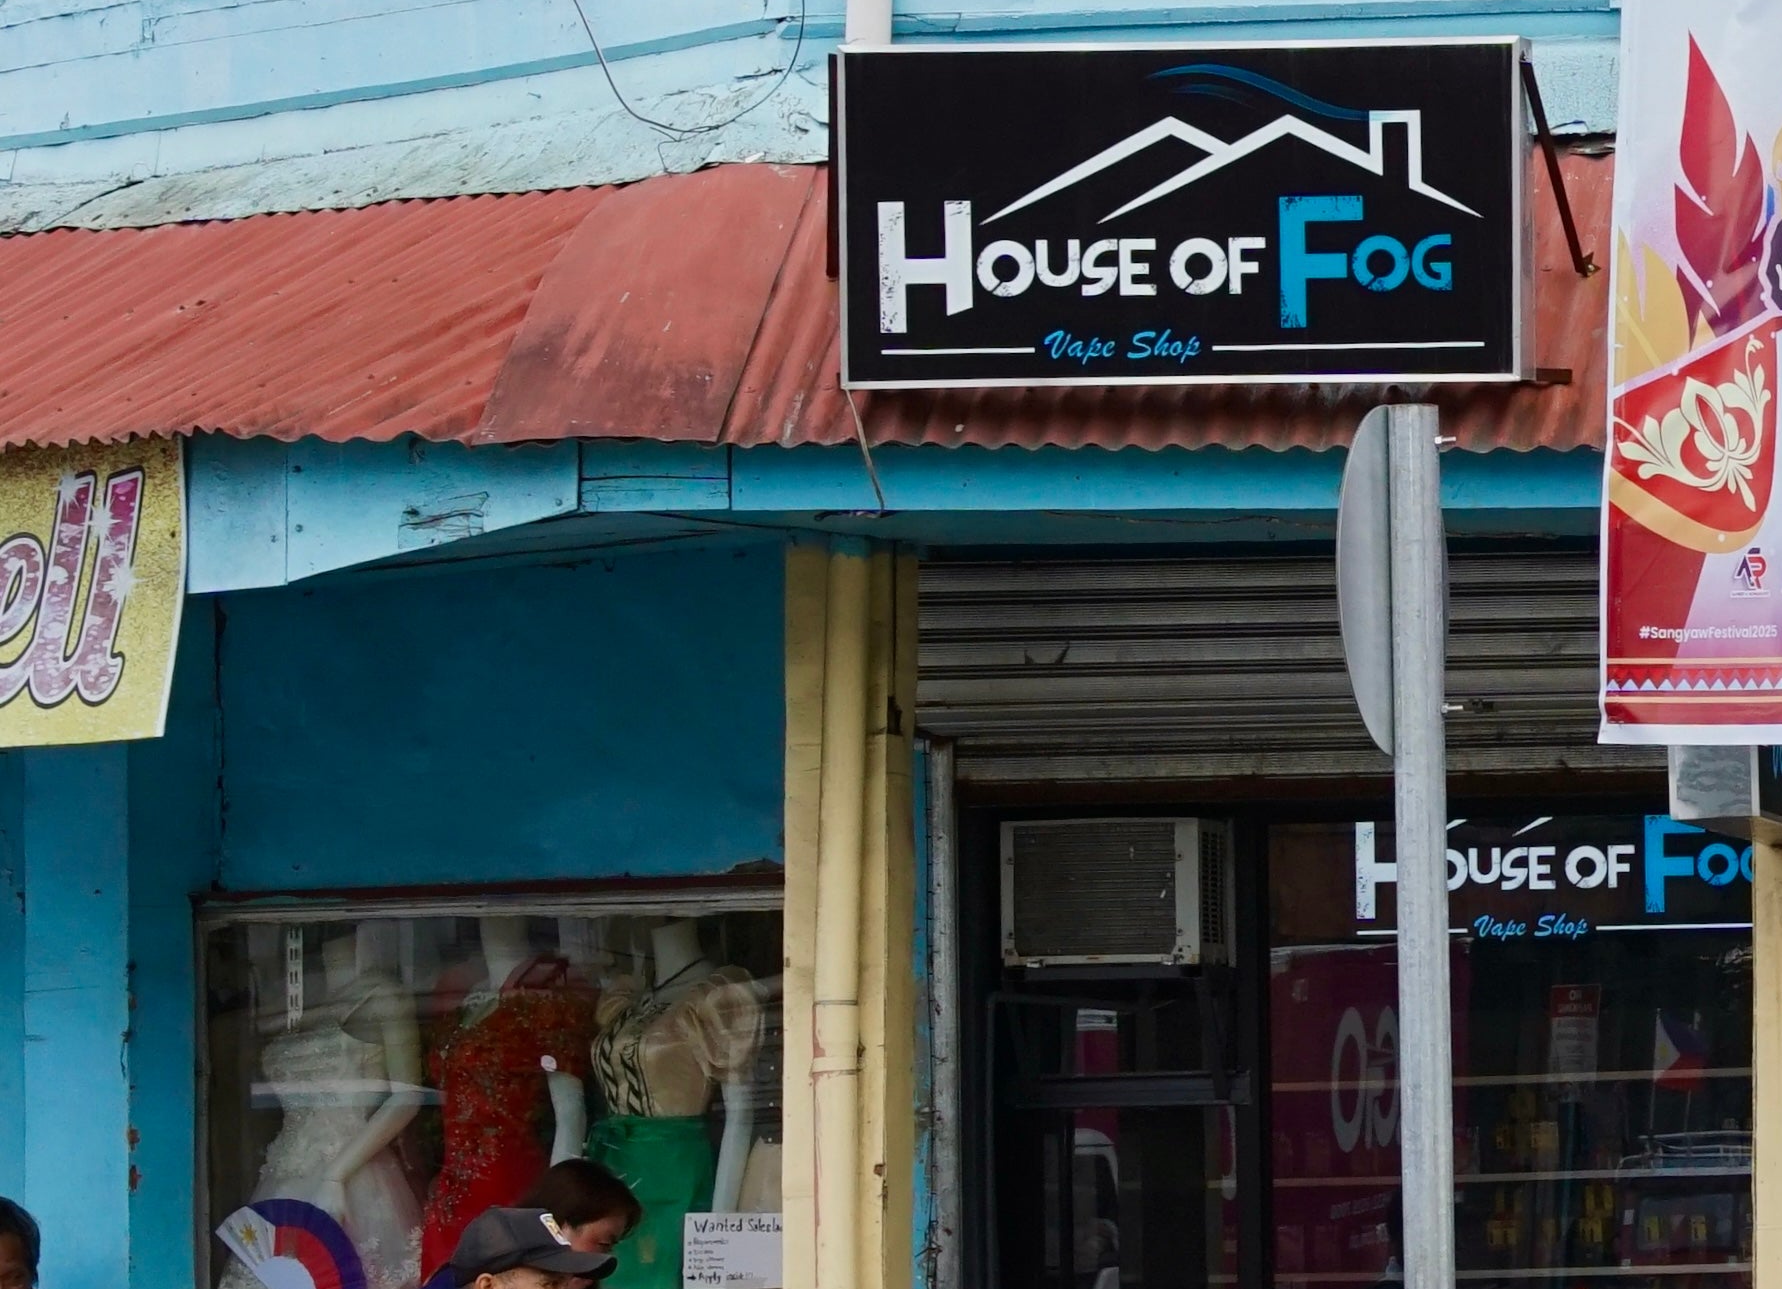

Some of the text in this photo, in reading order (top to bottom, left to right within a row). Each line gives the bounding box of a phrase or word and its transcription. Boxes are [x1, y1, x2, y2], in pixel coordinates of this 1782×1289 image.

[877, 195, 1453, 333] HOUSE OF FOG
[1043, 329, 1202, 365] Vape Shop
[1639, 624, 1778, 643] #SangyawFestival2025
[1565, 844, 1636, 889] OF
[1473, 913, 1590, 941] Vape Shop
[693, 1217, 743, 1233] Wanted
